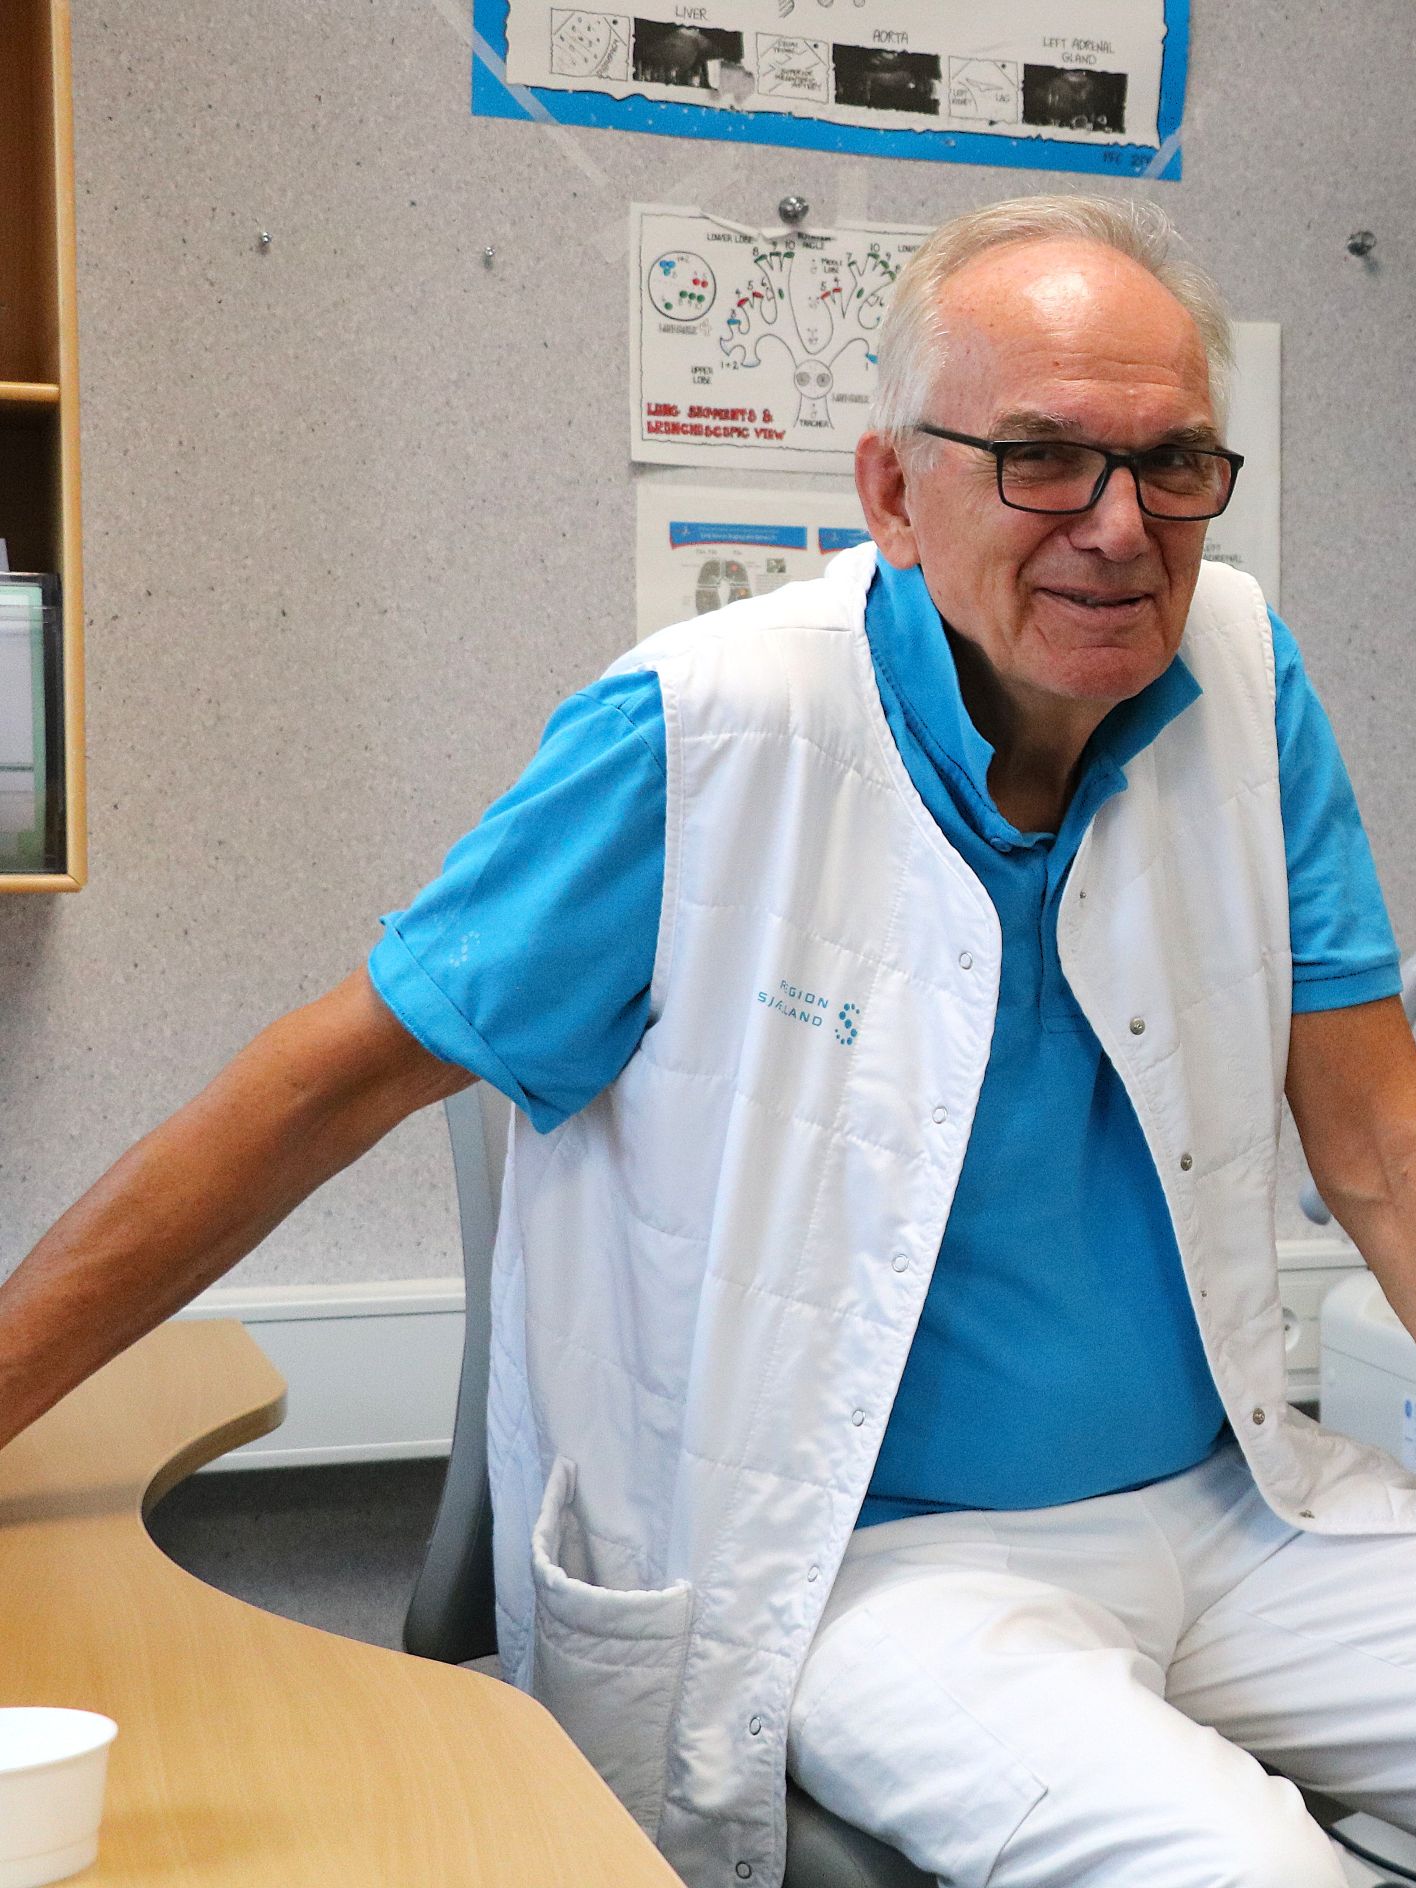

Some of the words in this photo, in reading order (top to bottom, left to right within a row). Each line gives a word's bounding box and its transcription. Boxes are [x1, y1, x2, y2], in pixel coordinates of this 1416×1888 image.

[675, 5, 708, 21] LIVER
[872, 28, 909, 45] AORTA
[1043, 36, 1068, 49] LEFT
[1071, 38, 1115, 55] ADRENAL
[1061, 53, 1098, 65] GLAND
[706, 232, 733, 242] LOWER
[785, 239, 796, 250] 10
[869, 242, 881, 252] 10
[646, 402, 679, 417] LUNG
[687, 404, 758, 423] SEGMENTS
[753, 427, 787, 441] VIEW
